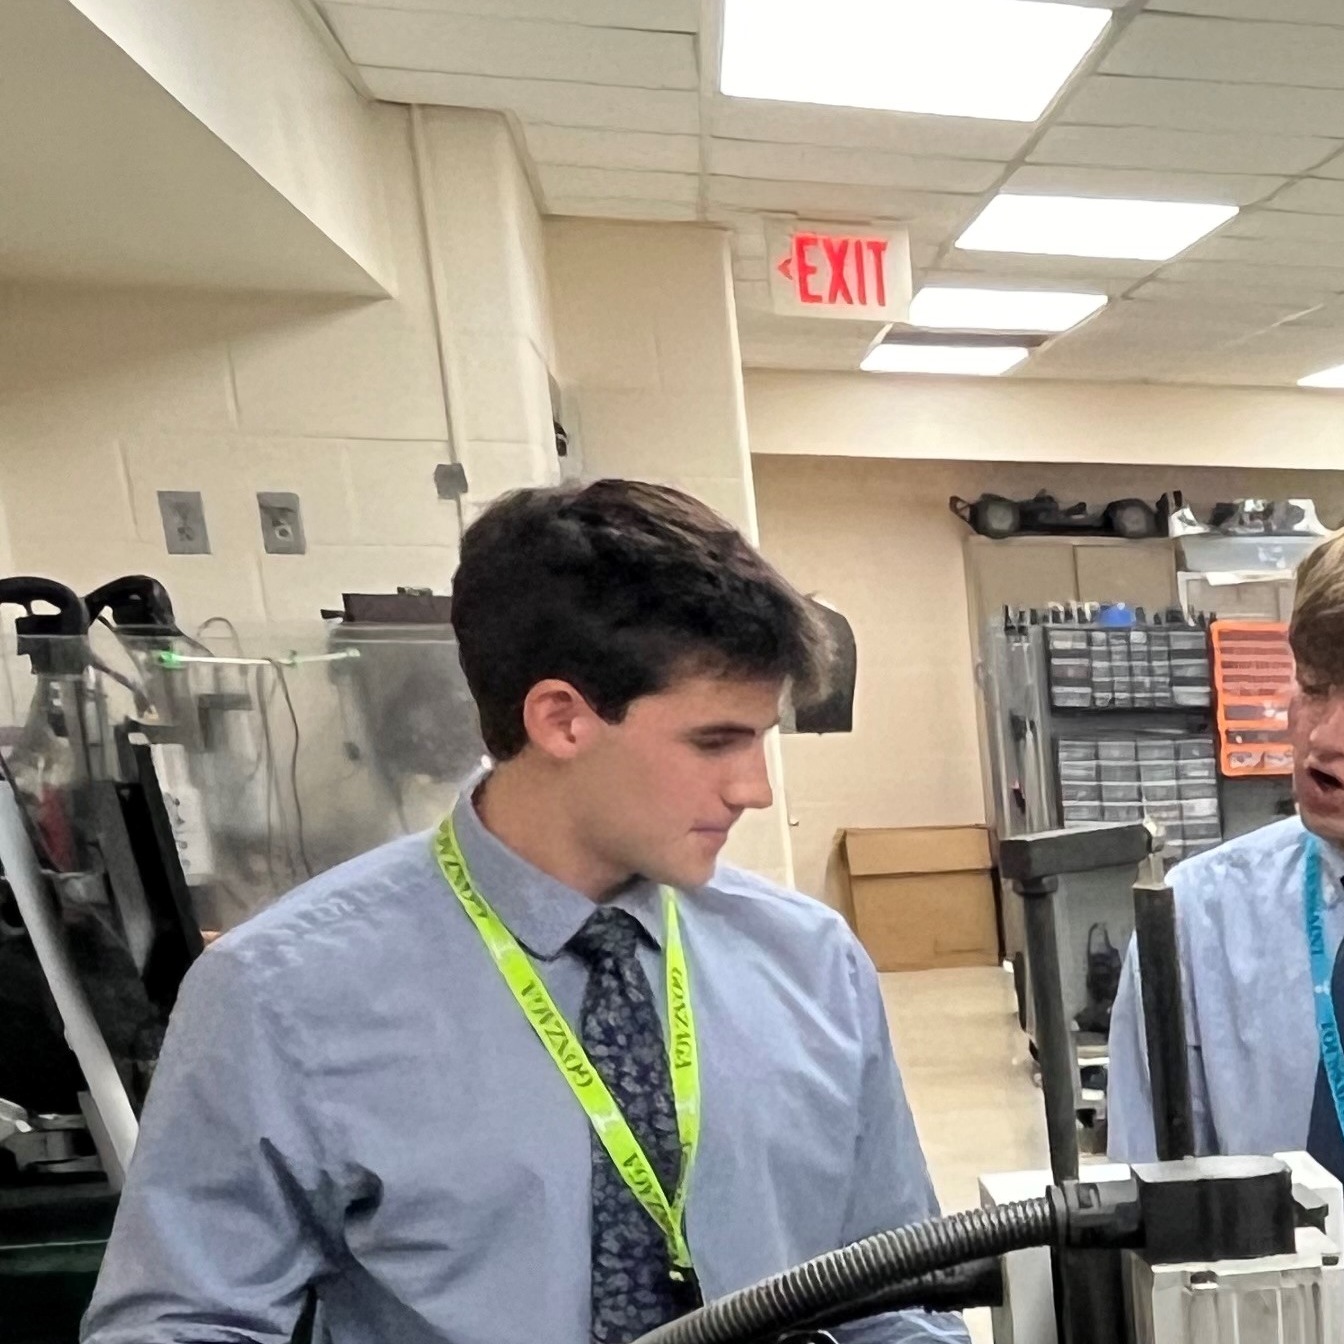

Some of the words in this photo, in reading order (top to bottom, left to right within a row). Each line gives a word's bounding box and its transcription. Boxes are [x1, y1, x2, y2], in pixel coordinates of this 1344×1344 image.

[795, 235, 888, 307] EXIT
[521, 980, 595, 1089] GONZAGA
[671, 967, 693, 1069] GONZAGA
